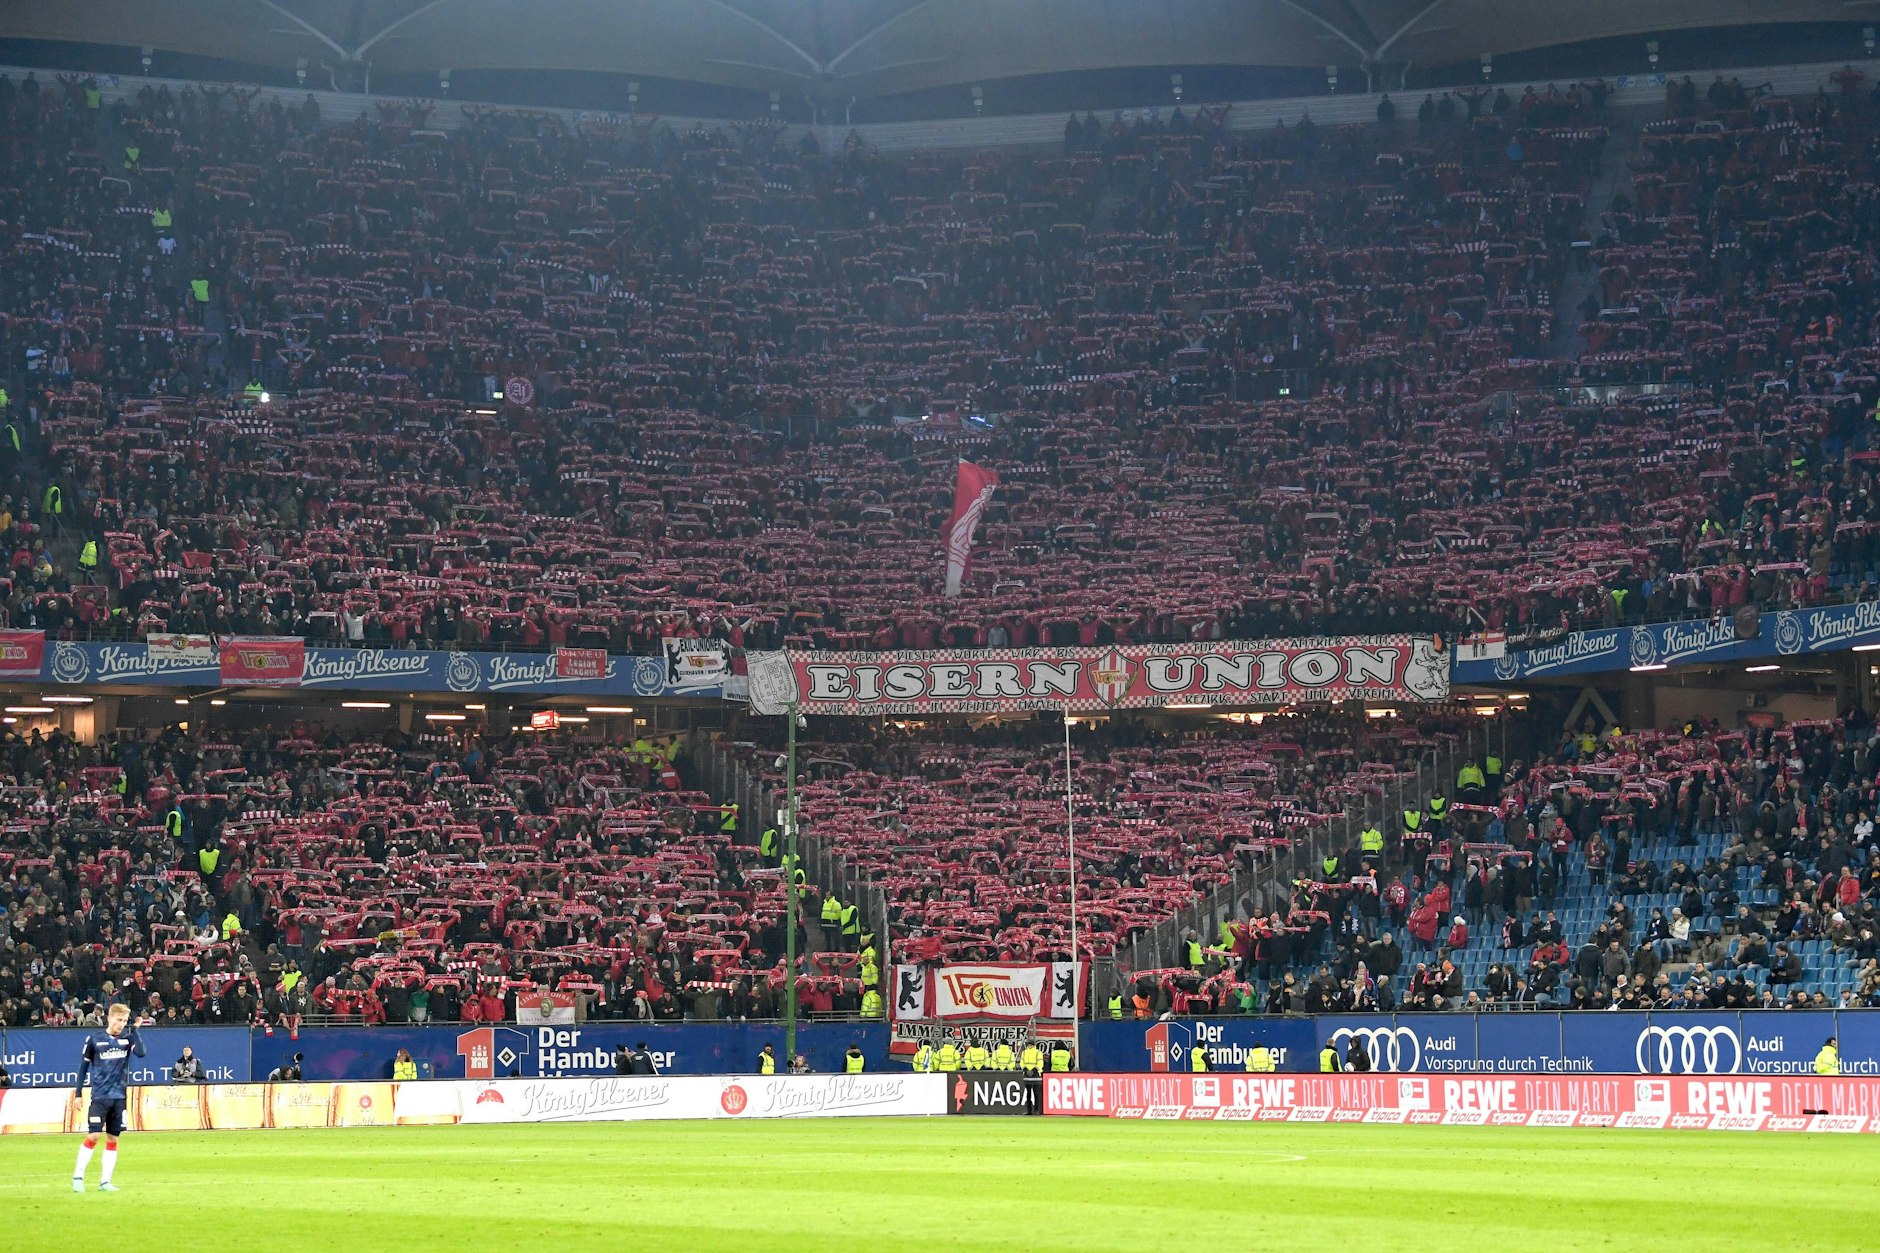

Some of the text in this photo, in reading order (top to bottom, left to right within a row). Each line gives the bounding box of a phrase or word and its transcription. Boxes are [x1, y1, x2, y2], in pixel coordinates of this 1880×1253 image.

[1808, 610, 1856, 642] König
[1057, 647, 1076, 658] BIS
[1661, 625, 1707, 655] König
[354, 649, 430, 673] Pilsener
[487, 656, 547, 683] König
[806, 661, 1083, 703] EISERN
[1142, 646, 1401, 693] UNION
[994, 986, 1033, 1007] UNION
[538, 1027, 581, 1048] Der
[897, 1022, 1029, 1040] IMMER WEITER
[1195, 1021, 1224, 1043] Der
[1425, 1036, 1456, 1051] Audi
[1746, 1036, 1784, 1052] Audi
[0, 1050, 35, 1065] udi
[1424, 1055, 1594, 1072] Vorsprung durch Technik
[520, 1077, 670, 1116] König Pilsener
[762, 1075, 904, 1113] König Pilsener
[1048, 1077, 1182, 1111] REWE DEIN MARKT
[1232, 1078, 1385, 1108] REWE DEIN MARKT
[1443, 1079, 1620, 1112] REWE DEIN MARKT
[1687, 1081, 1772, 1115] REWE
[1781, 1083, 1823, 1115] DEIN
[1115, 1105, 1144, 1119] tipico
[1150, 1105, 1179, 1119] tipico
[1185, 1105, 1215, 1120] tipico
[1222, 1105, 1252, 1121] tipico
[1258, 1106, 1289, 1121] tipico
[1295, 1106, 1326, 1121] tipico
[1332, 1107, 1364, 1122] tipico
[1371, 1107, 1402, 1123] tipico
[1409, 1109, 1441, 1124] tipico
[1450, 1109, 1482, 1125] tipico
[1491, 1109, 1527, 1125] tipico
[1535, 1110, 1570, 1126] tipico
[1578, 1111, 1615, 1127] tipico
[1624, 1111, 1658, 1127] tipico
[1670, 1112, 1708, 1129] tipico
[1718, 1113, 1755, 1129] tipico
[1766, 1114, 1807, 1130] tipico
[1817, 1115, 1858, 1131] tipico
